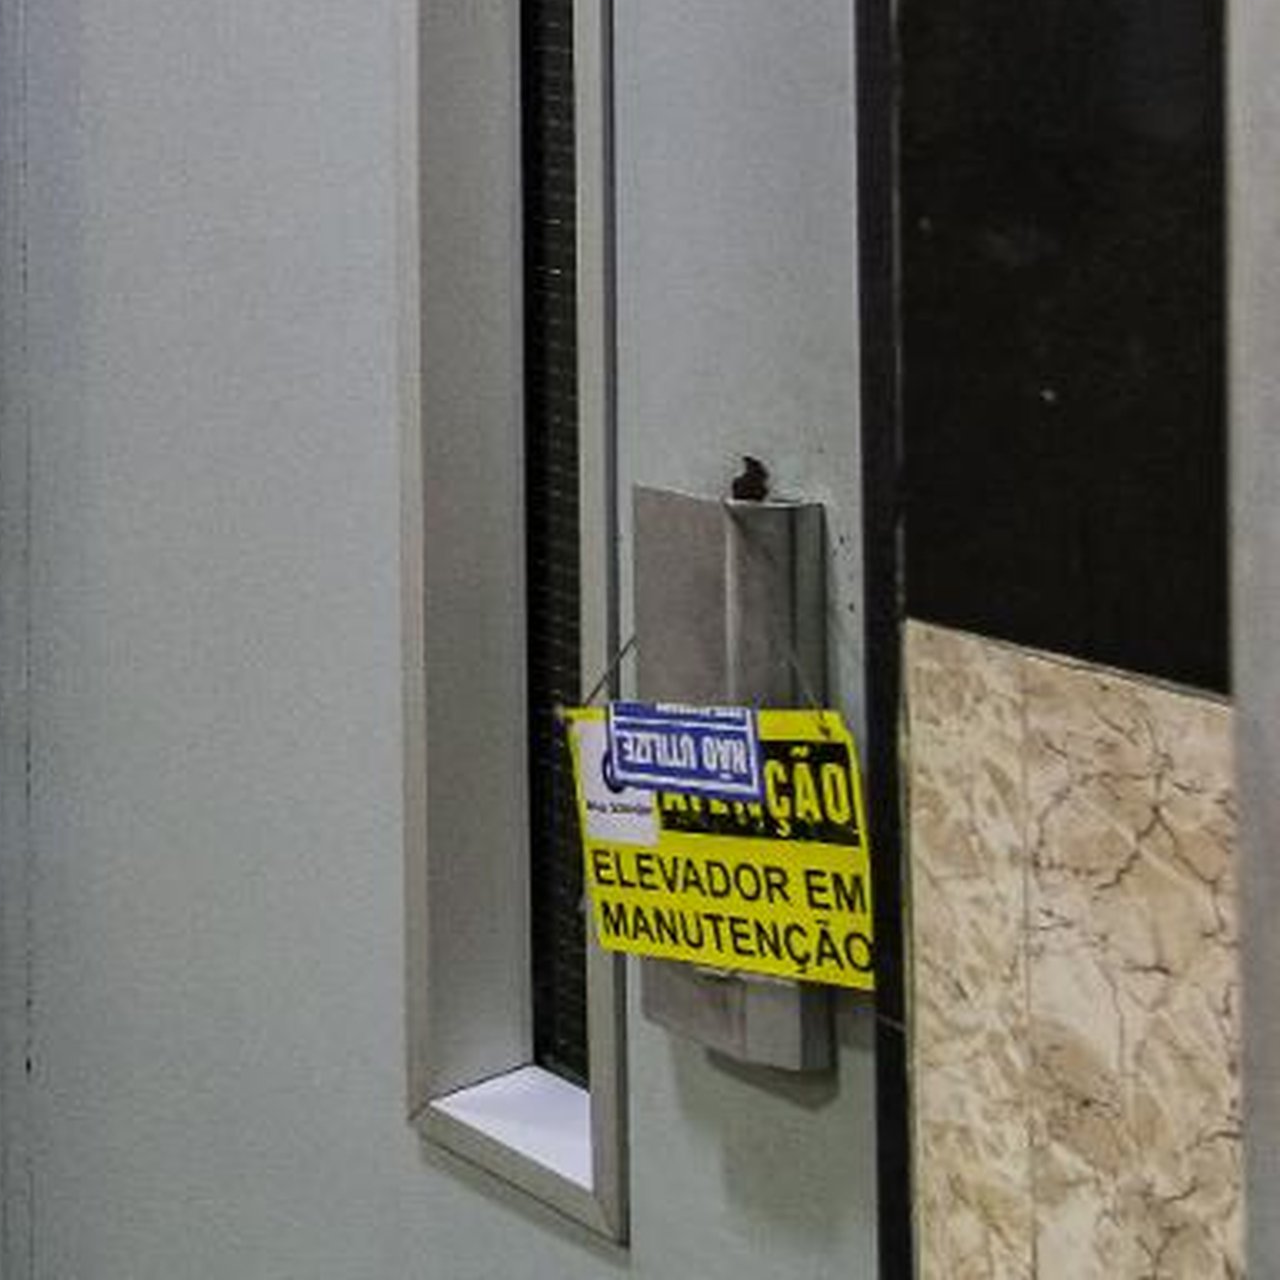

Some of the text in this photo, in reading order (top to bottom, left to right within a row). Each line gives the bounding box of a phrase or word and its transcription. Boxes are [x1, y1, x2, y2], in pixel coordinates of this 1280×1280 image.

[591, 848, 867, 914] ELEVADOR EM
[599, 901, 874, 973] MANUTENÇÃO
